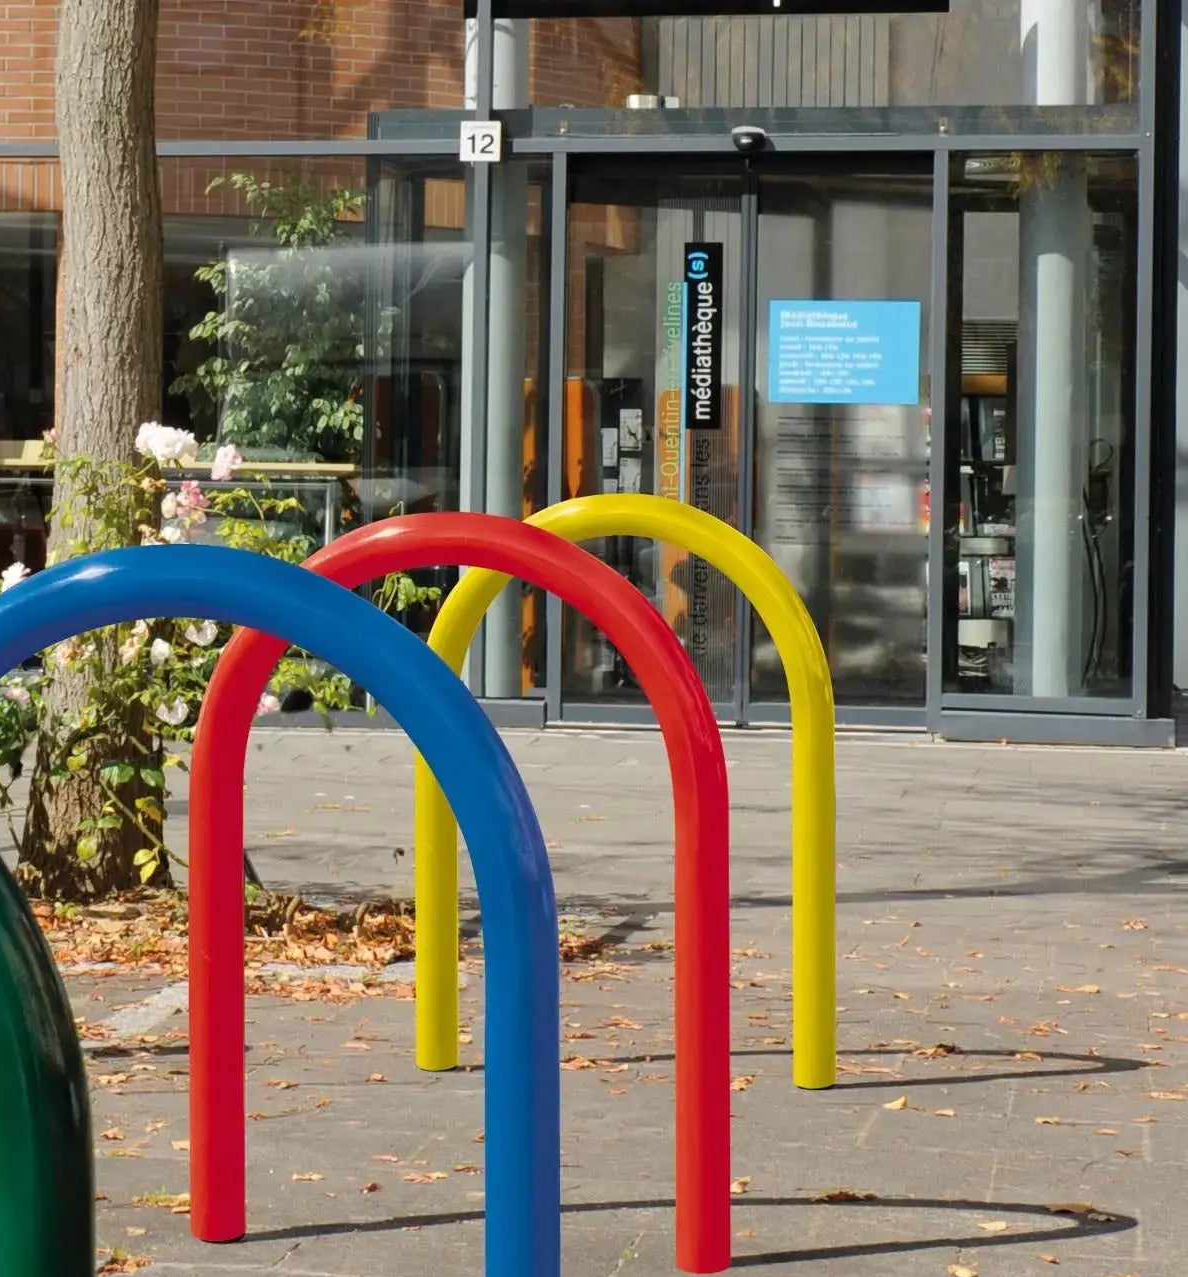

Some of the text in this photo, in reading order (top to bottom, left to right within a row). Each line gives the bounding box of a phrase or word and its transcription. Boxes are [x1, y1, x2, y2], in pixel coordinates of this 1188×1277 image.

[467, 134, 494, 154] 12
[688, 252, 717, 420] médiathèque(s)
[694, 475, 710, 512] ans
